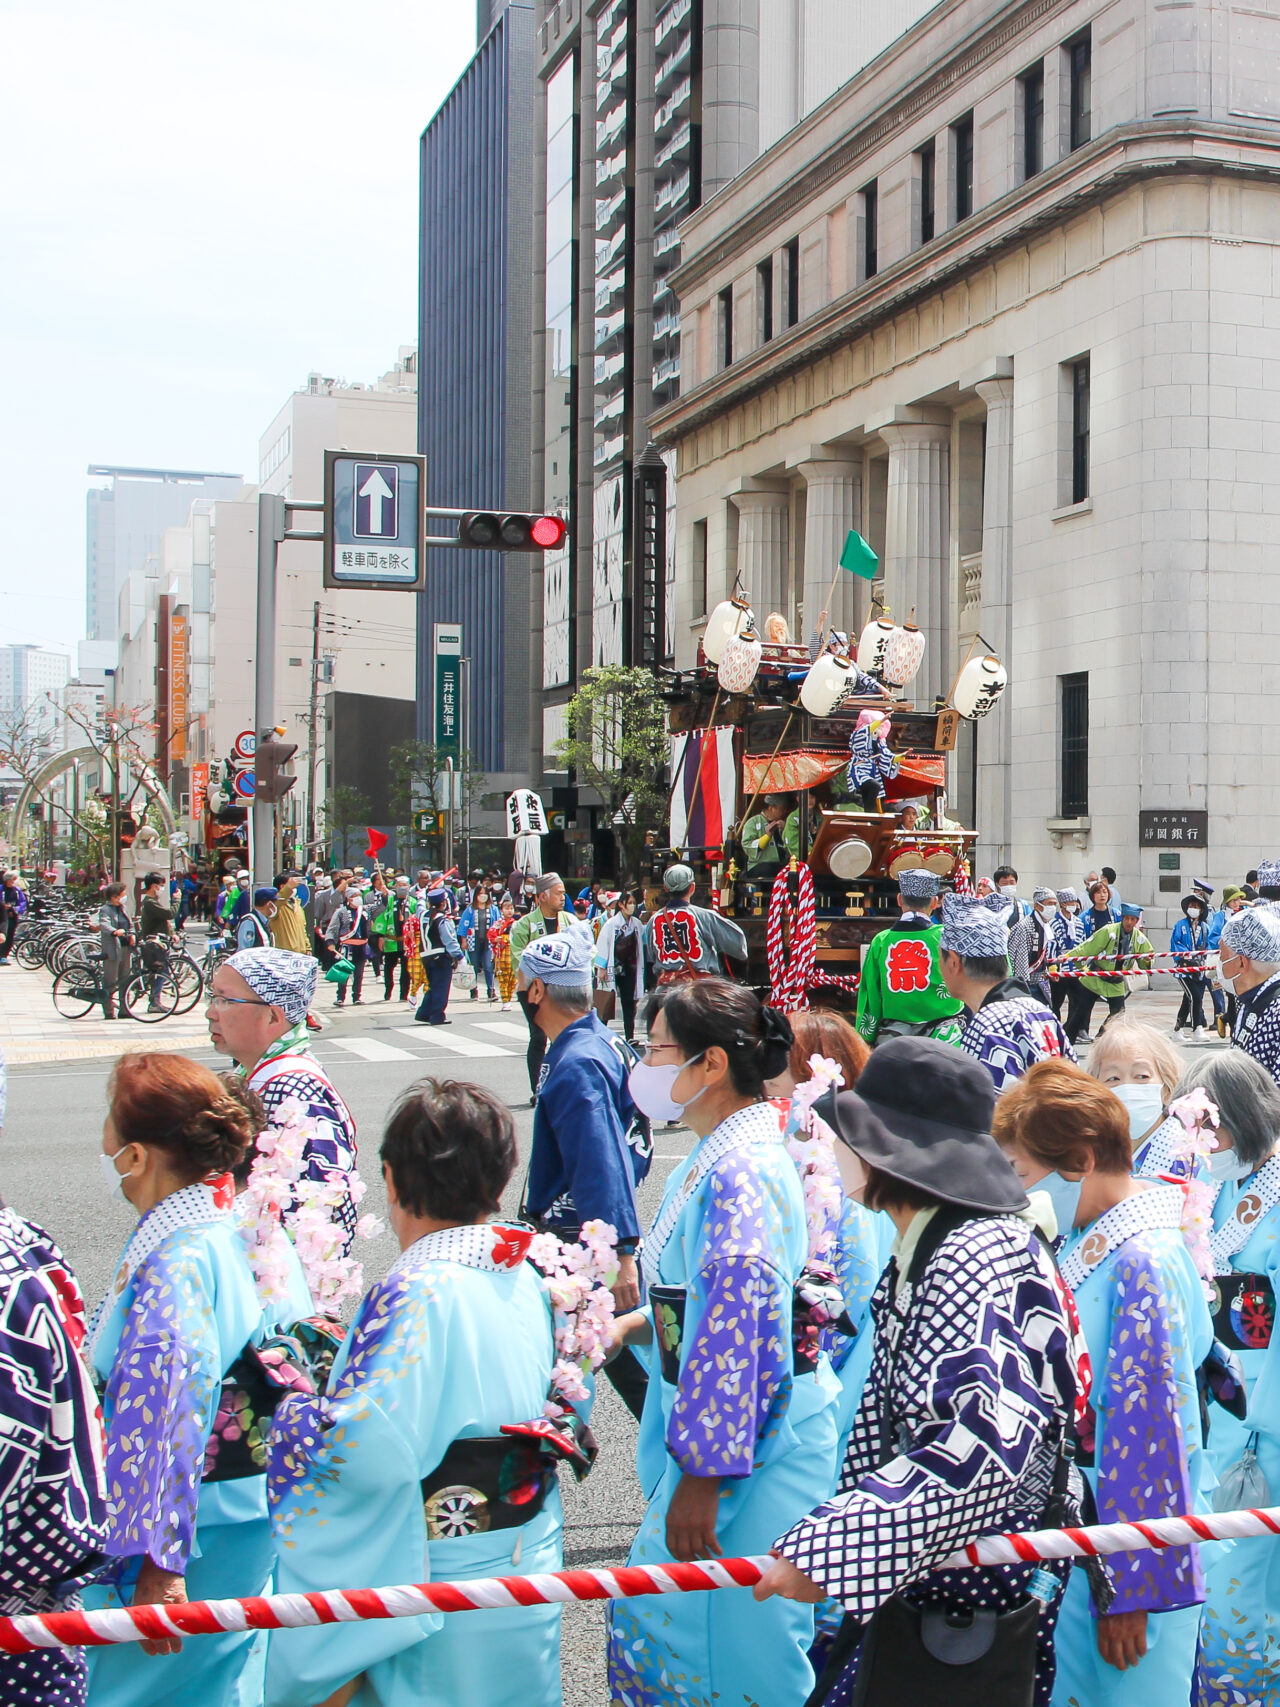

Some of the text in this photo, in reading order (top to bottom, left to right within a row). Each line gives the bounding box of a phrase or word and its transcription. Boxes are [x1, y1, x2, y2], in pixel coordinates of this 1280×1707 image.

[341, 551, 409, 570] 軽車両を除く
[173, 640, 185, 727] FITNESS CLUB
[443, 671, 454, 736] 三井住友海上
[242, 738, 256, 750] 30
[421, 815, 434, 830] P
[885, 939, 932, 993] 祭
